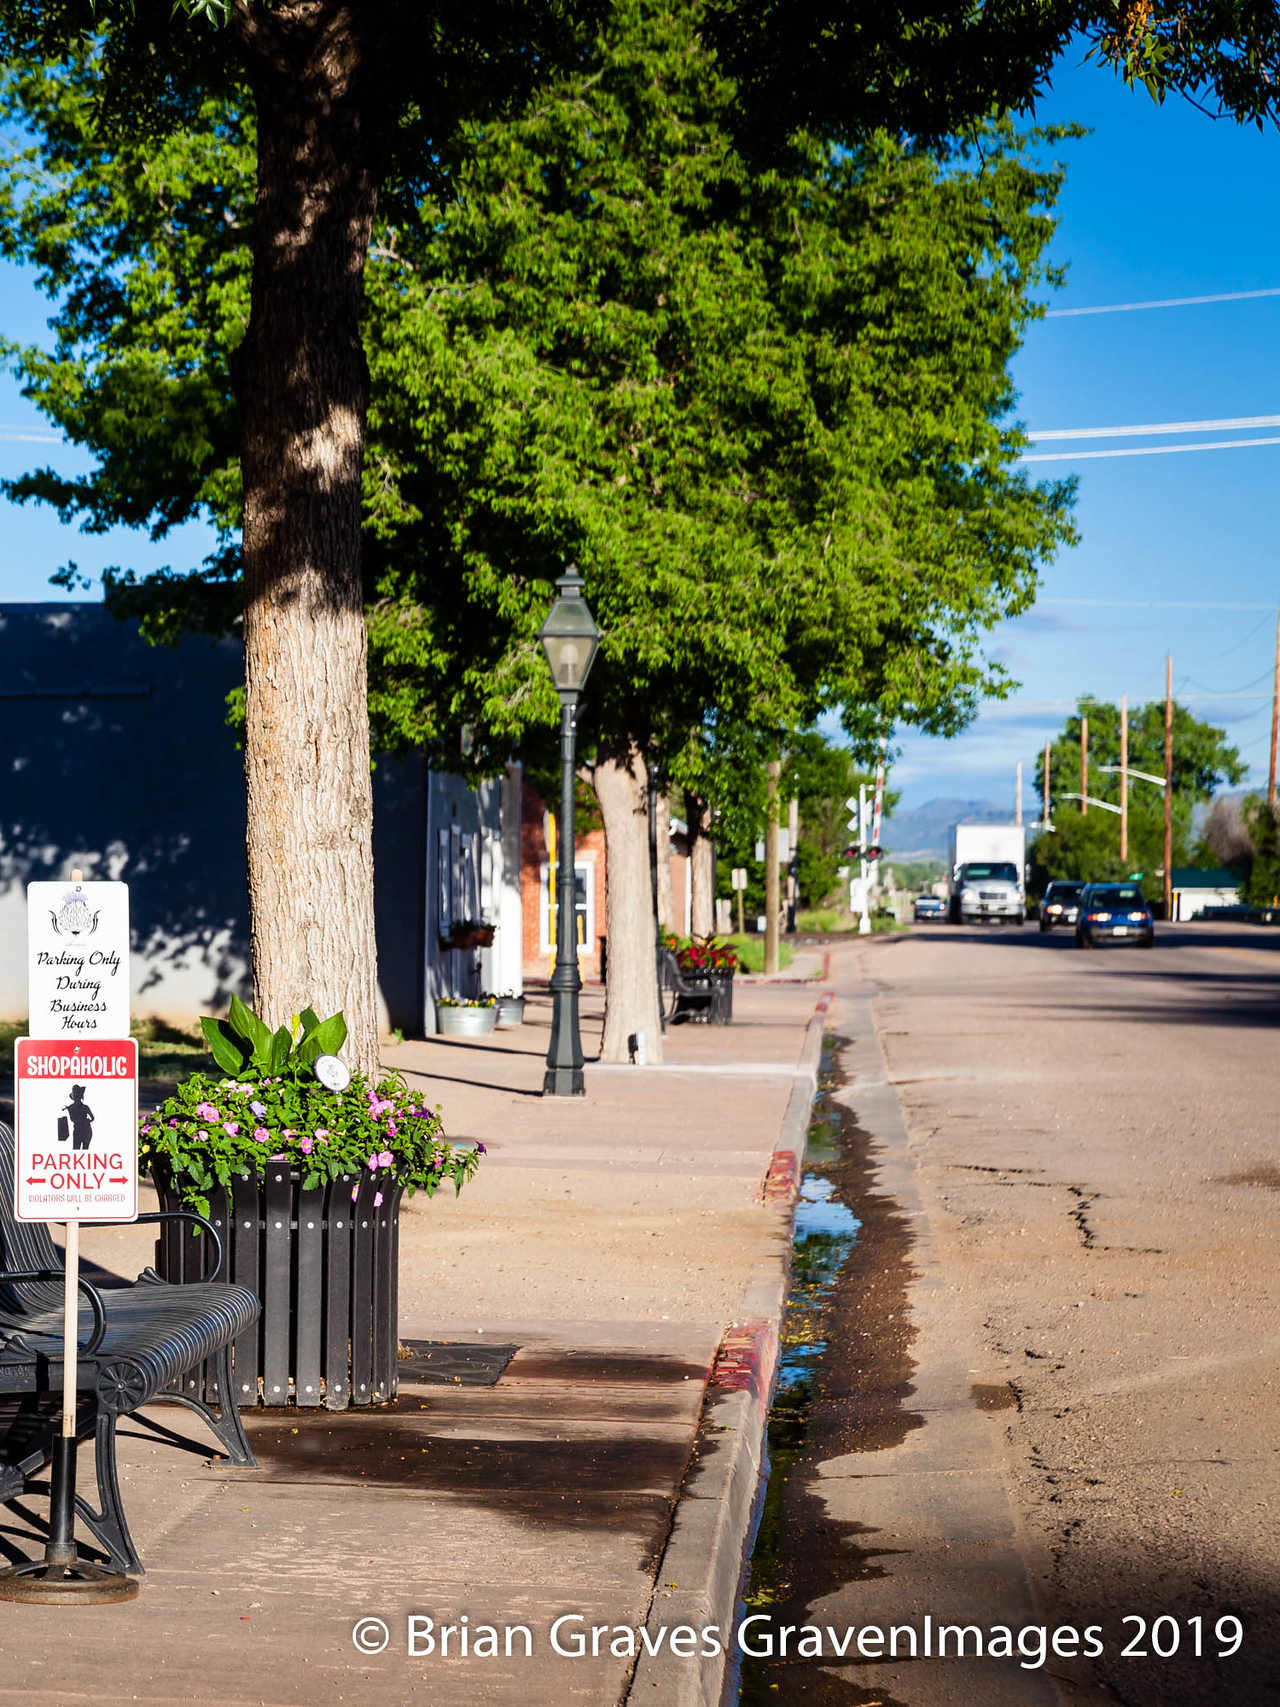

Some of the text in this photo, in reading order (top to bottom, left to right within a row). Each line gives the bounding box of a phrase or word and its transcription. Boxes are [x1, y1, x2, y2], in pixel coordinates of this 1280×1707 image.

[36, 950, 121, 976] Parking Only
[55, 975, 102, 1000] During
[50, 999, 108, 1013] Business
[61, 1014, 98, 1030] Hours
[26, 1055, 127, 1077] SHOPAHOLIC
[31, 1153, 123, 1170] PARKING
[50, 1173, 106, 1190] ONLY
[28, 1193, 126, 1203] VIOLATORS WILL BE CHARGED
